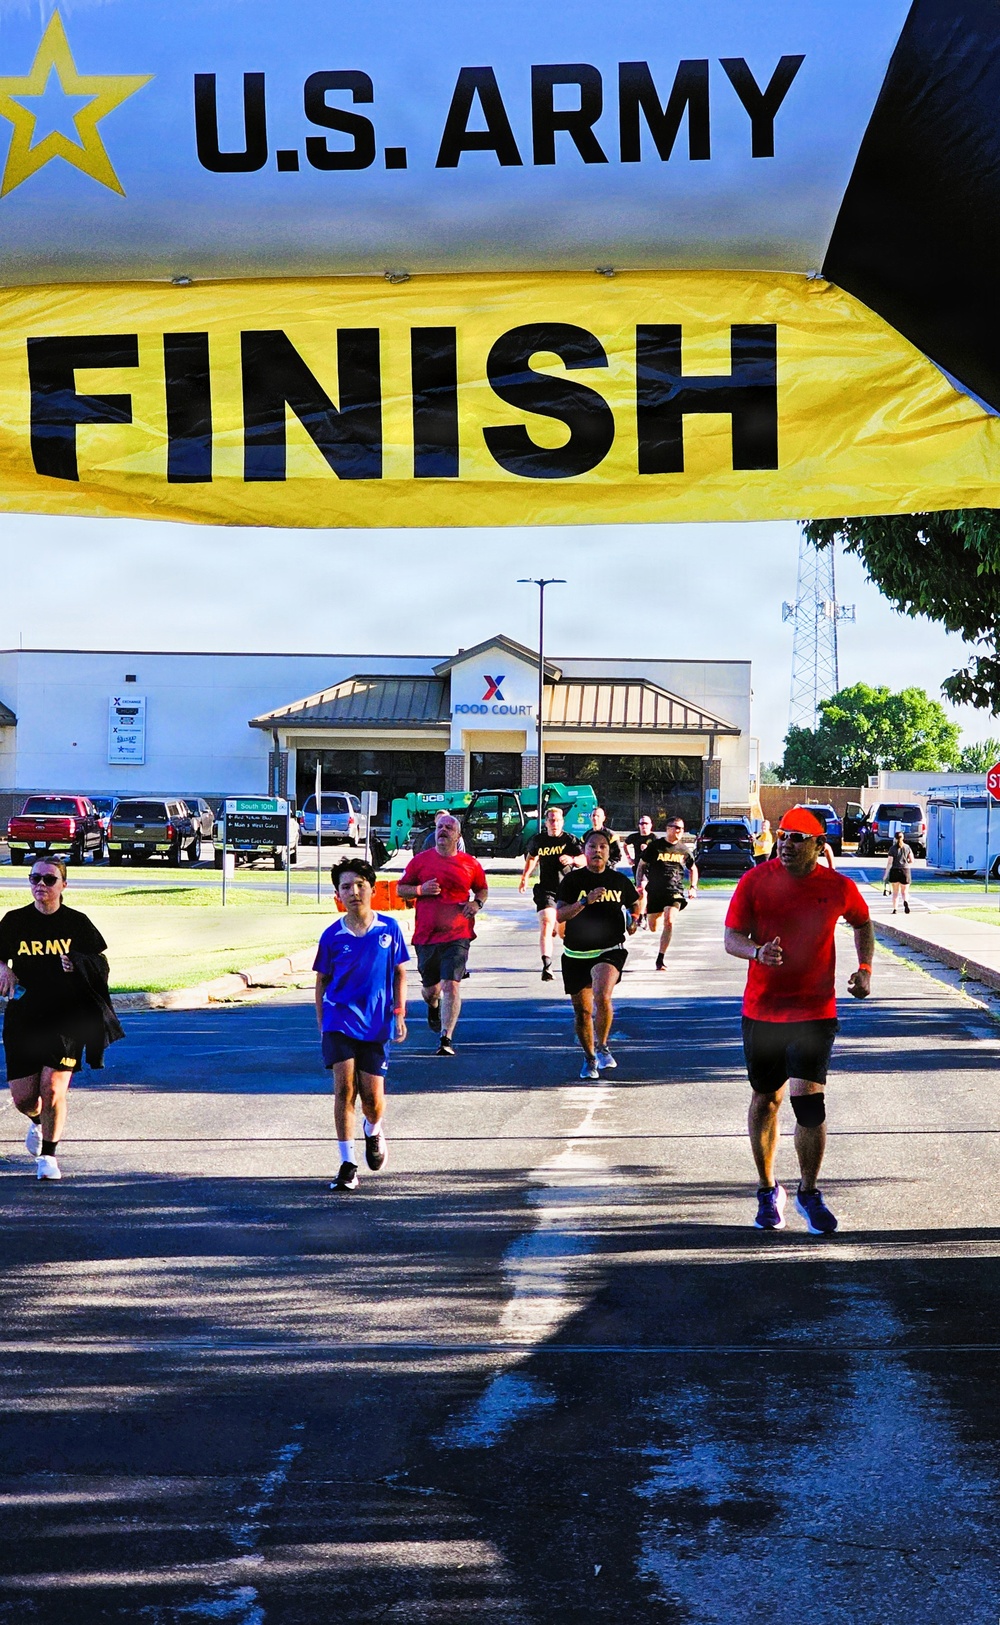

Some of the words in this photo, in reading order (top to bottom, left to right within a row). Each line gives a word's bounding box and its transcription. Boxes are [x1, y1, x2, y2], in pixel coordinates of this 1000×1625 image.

[194, 69, 407, 173] U.S.
[436, 54, 806, 168] ARMY
[27, 322, 779, 482] FINISH
[455, 704, 488, 714] FOOD
[491, 705, 533, 716] COURT
[422, 794, 445, 802] JCB
[538, 844, 566, 857] ARMY
[657, 853, 685, 863] ARMY
[577, 889, 622, 903] AMY
[17, 938, 72, 956] ARMY
